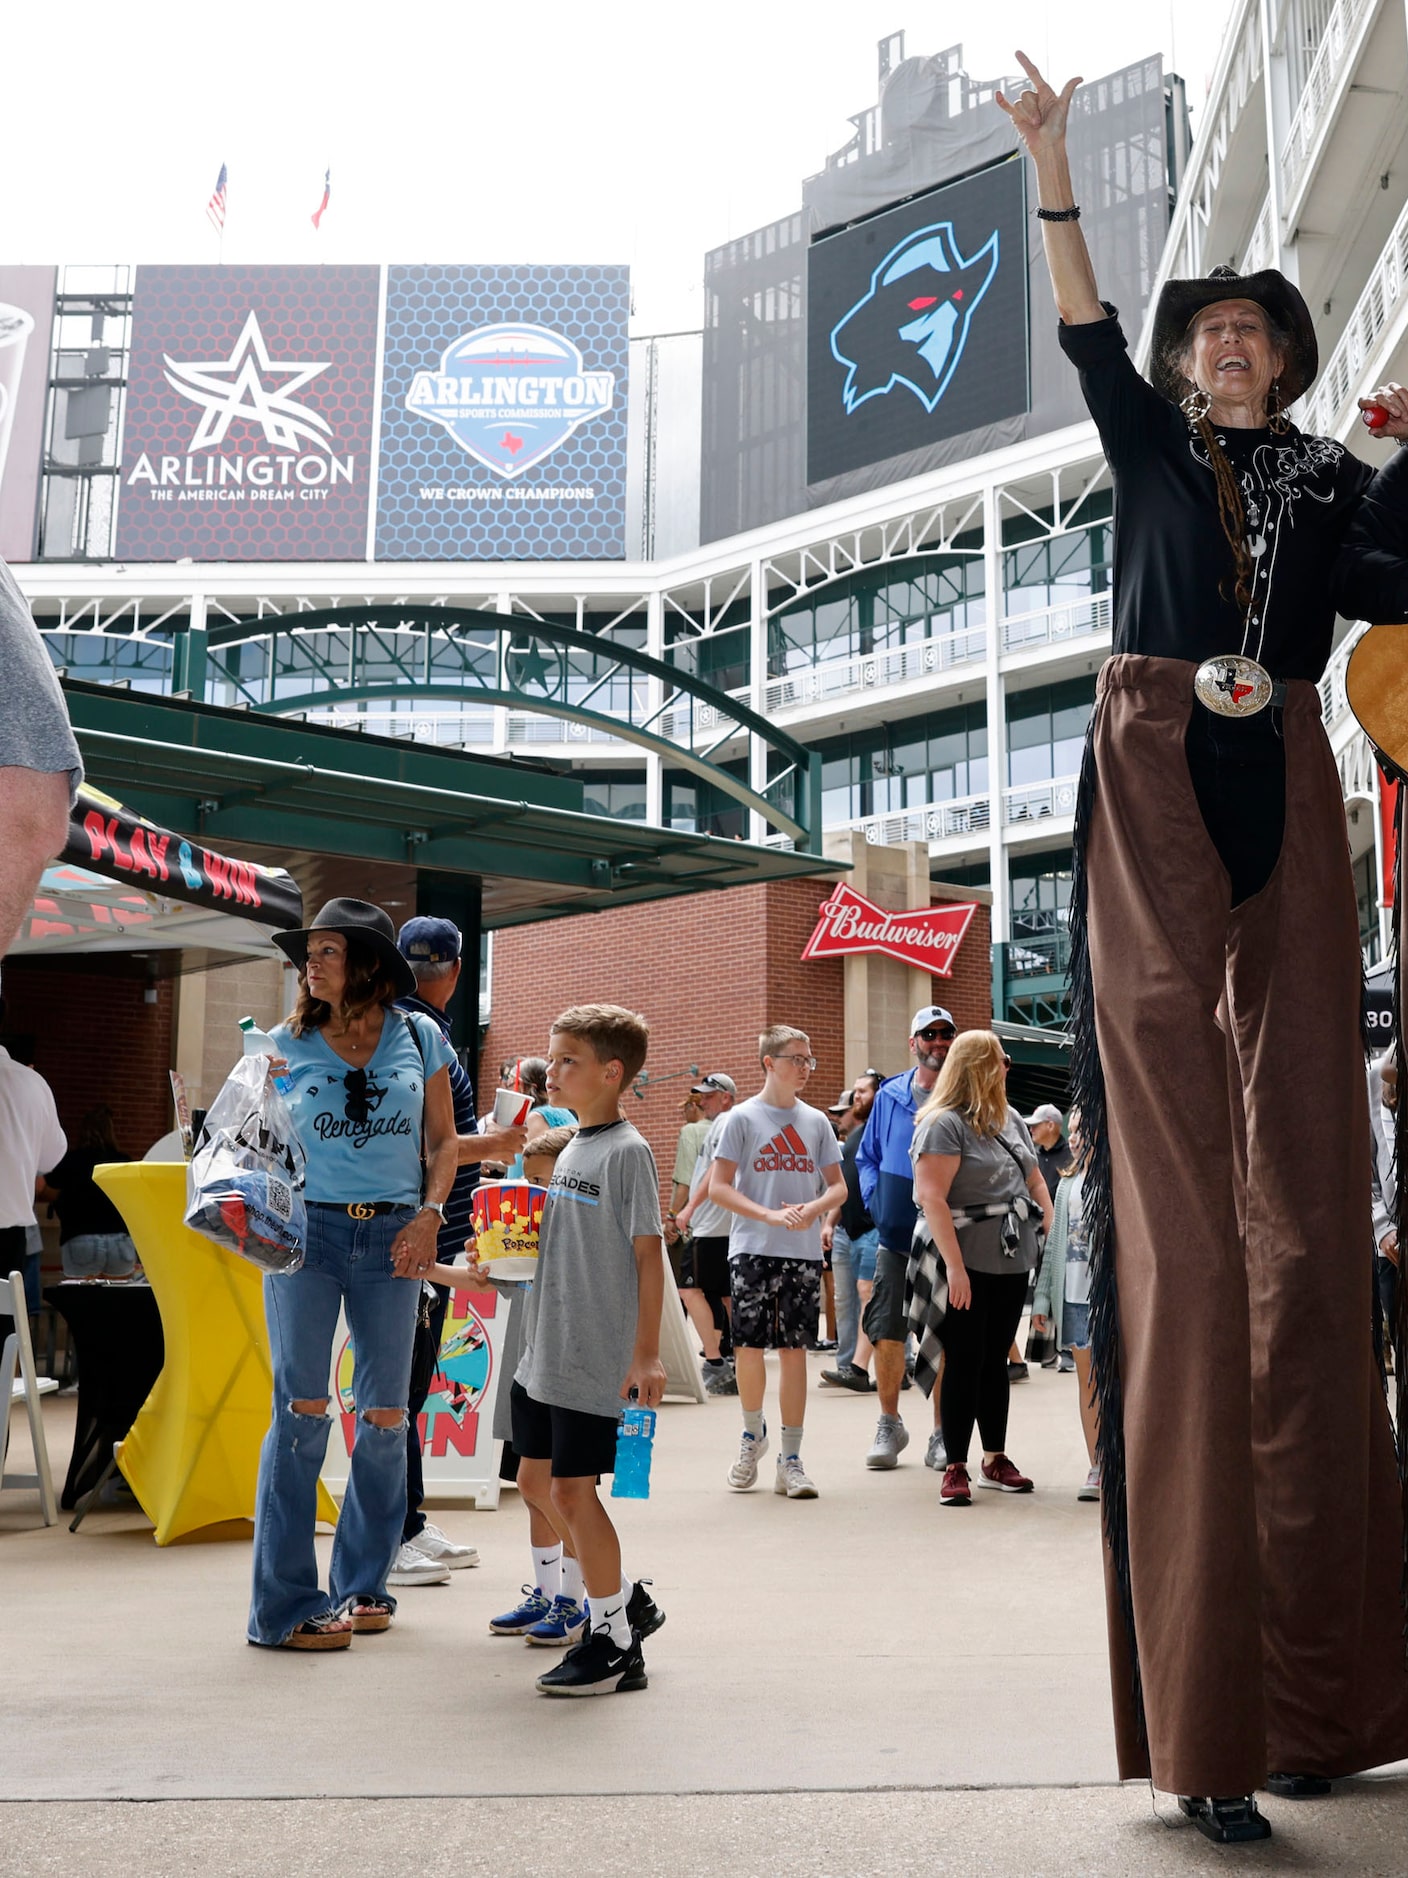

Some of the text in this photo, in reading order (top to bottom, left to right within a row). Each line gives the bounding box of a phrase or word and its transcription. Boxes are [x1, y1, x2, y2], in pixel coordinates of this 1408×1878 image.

[411, 376, 609, 406] ARLINGTON
[459, 408, 562, 418] SPORTS COMMISSION
[126, 452, 354, 486] ARLINGTON
[150, 489, 329, 501] THE AMERICAN DREAM CITY
[419, 487, 594, 500] WE CROWN CHAMPIONS
[83, 810, 262, 908] PLAY & WIN
[824, 902, 961, 950] Budweiser
[306, 1070, 418, 1098] DALAS
[313, 1110, 412, 1149] Renegades
[753, 1152, 815, 1173] adidas
